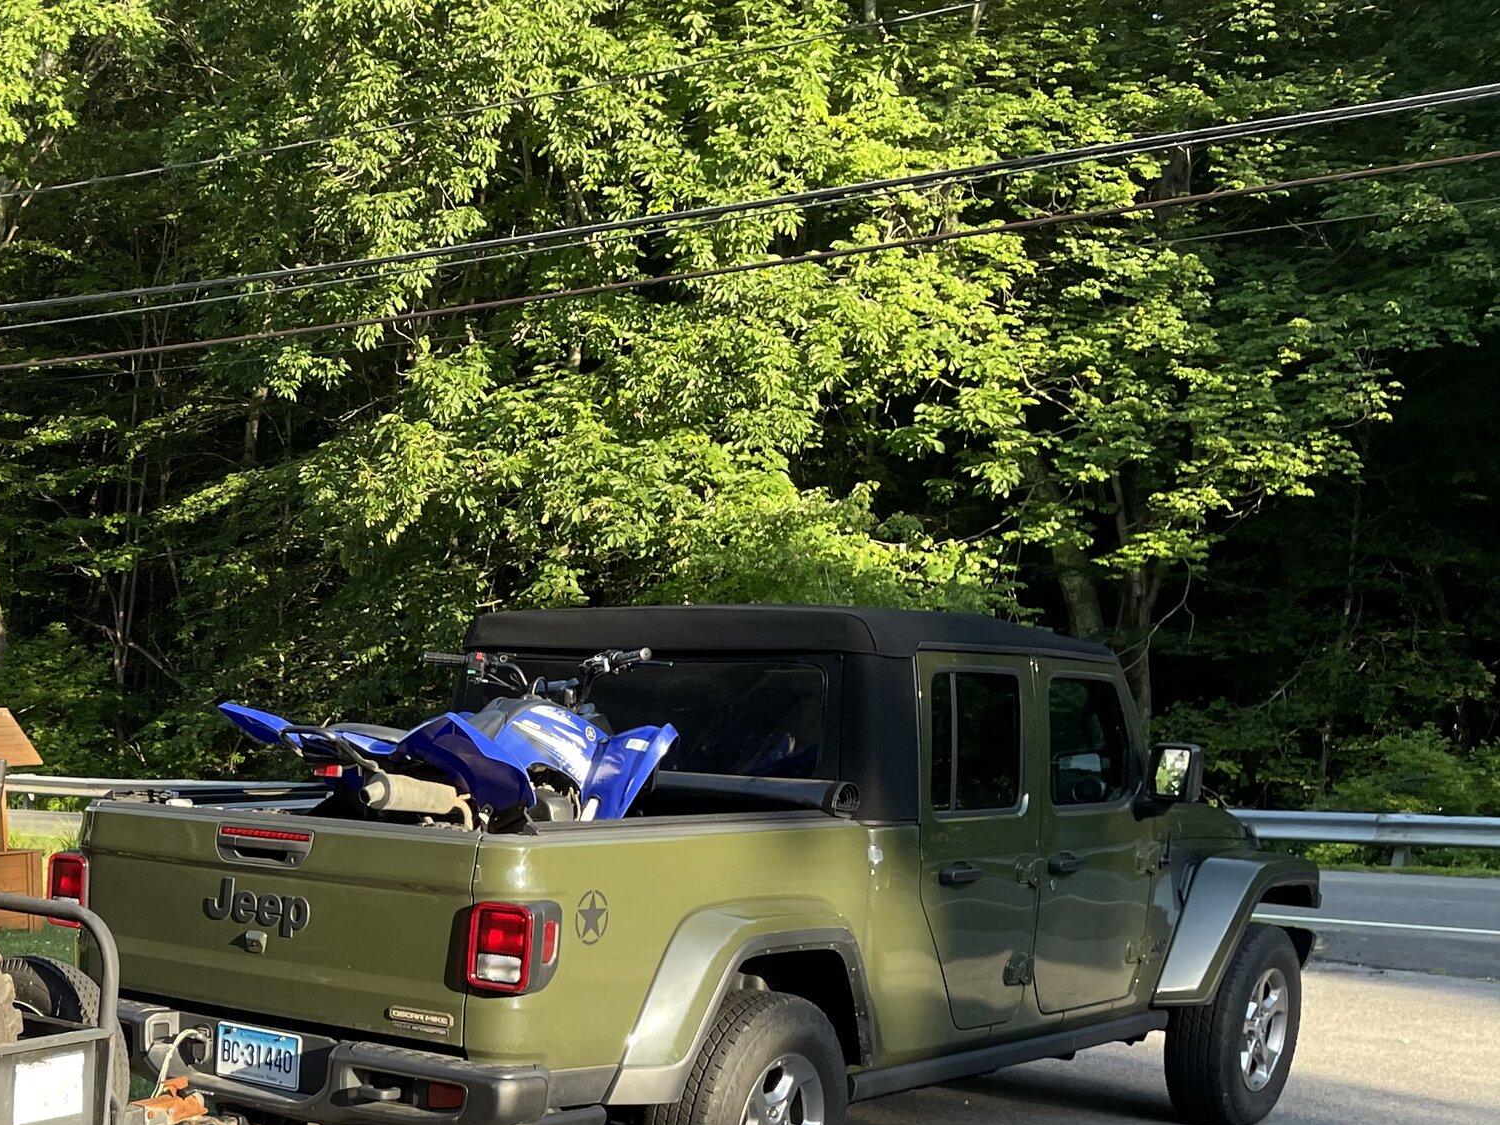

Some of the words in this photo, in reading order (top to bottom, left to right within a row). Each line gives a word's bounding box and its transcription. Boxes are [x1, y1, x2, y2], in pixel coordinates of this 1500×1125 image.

[204, 876, 311, 938] Jeep
[392, 1009, 424, 1021] OSCAR
[425, 1014, 449, 1026] MIKE
